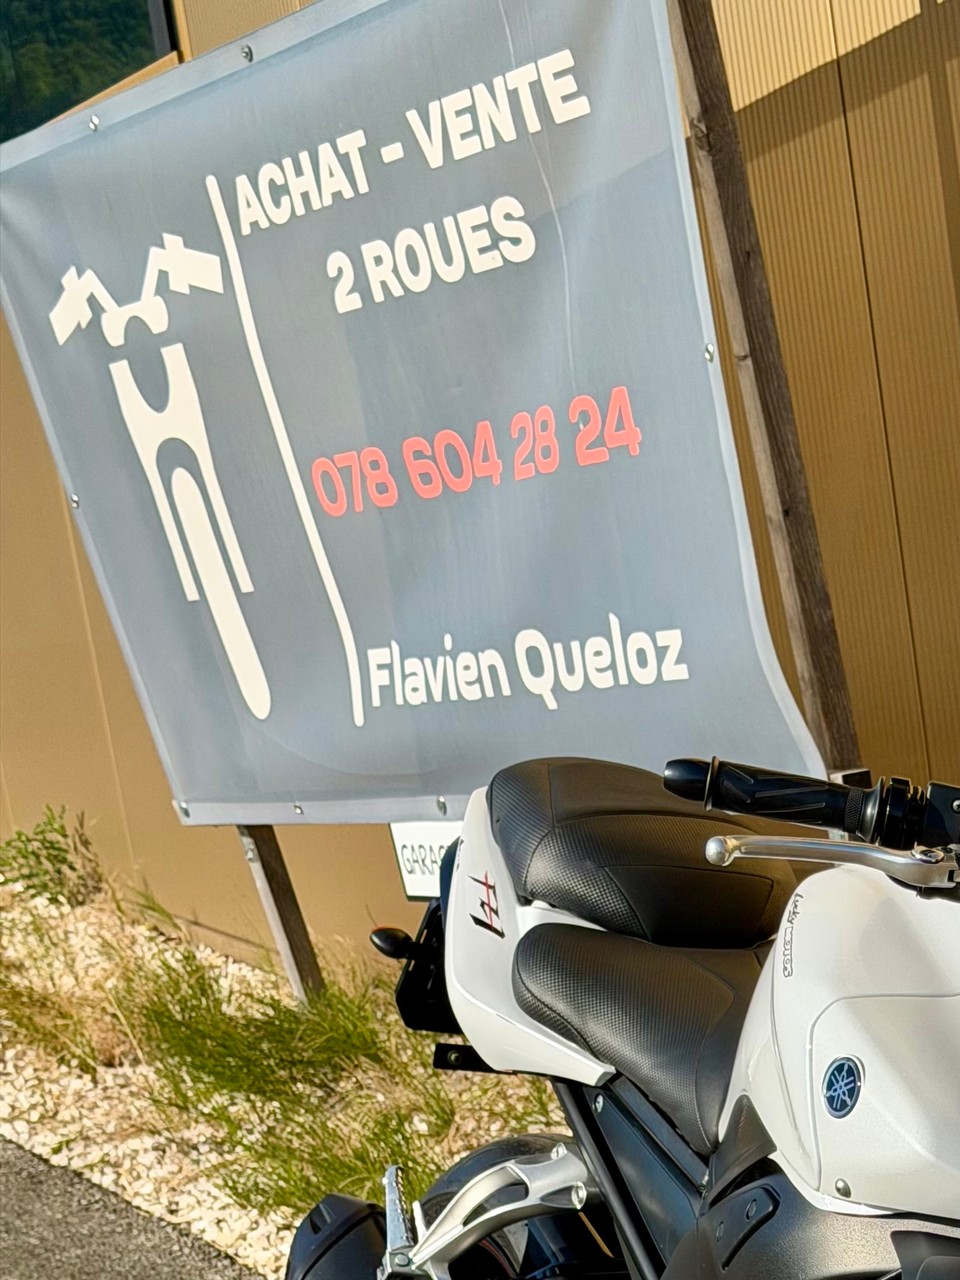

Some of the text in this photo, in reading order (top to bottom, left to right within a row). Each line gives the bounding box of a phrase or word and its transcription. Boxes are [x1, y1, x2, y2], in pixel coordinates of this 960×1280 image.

[235, 129, 370, 236] ACHAT
[405, 49, 591, 169] VENTE
[326, 195, 536, 314] 2 ROUES
[311, 386, 641, 517] 078 604 28 24
[367, 612, 689, 710] Flavien Queloz
[401, 843, 450, 875] GARA
